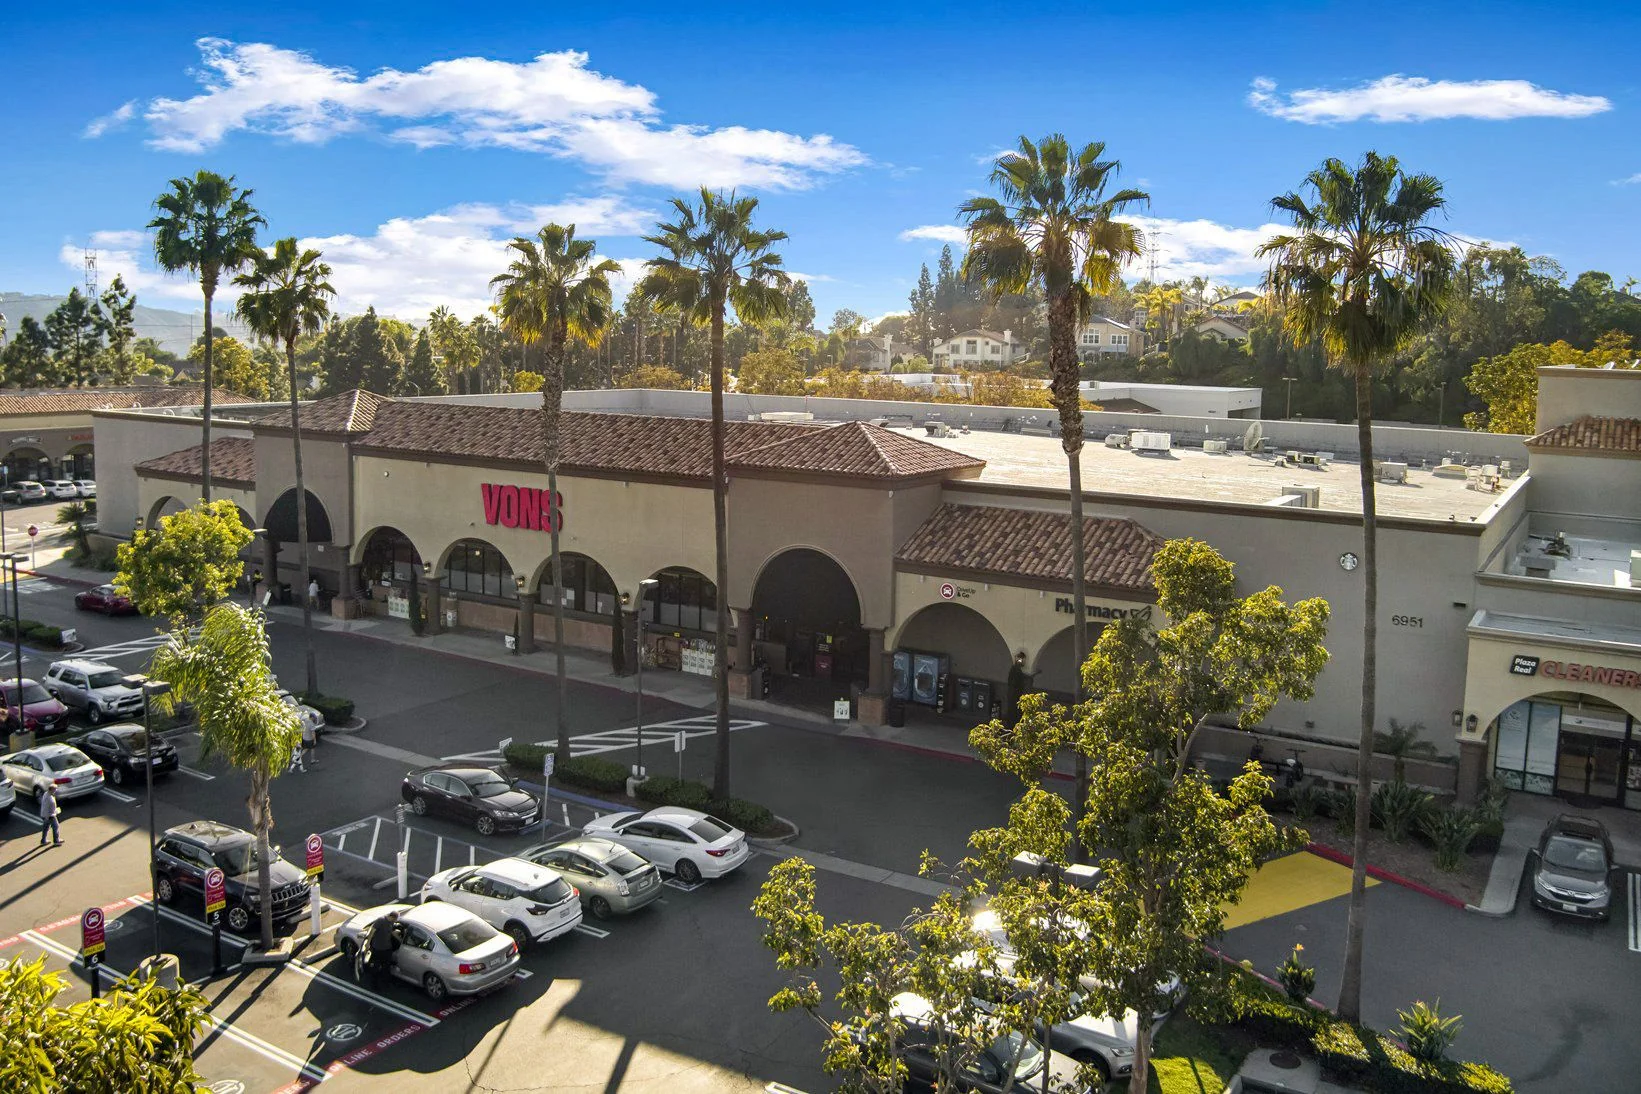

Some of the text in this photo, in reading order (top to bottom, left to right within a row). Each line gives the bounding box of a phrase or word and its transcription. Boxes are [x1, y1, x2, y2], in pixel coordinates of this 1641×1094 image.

[481, 483, 563, 533] VONS
[1055, 598, 1127, 621] Phmacy
[1391, 614, 1423, 628] 6951
[1515, 657, 1536, 667] Plaza
[1514, 665, 1531, 673] Real
[213, 911, 219, 920] 5
[92, 954, 98, 963] 6
[377, 1024, 421, 1048] ORDERS
